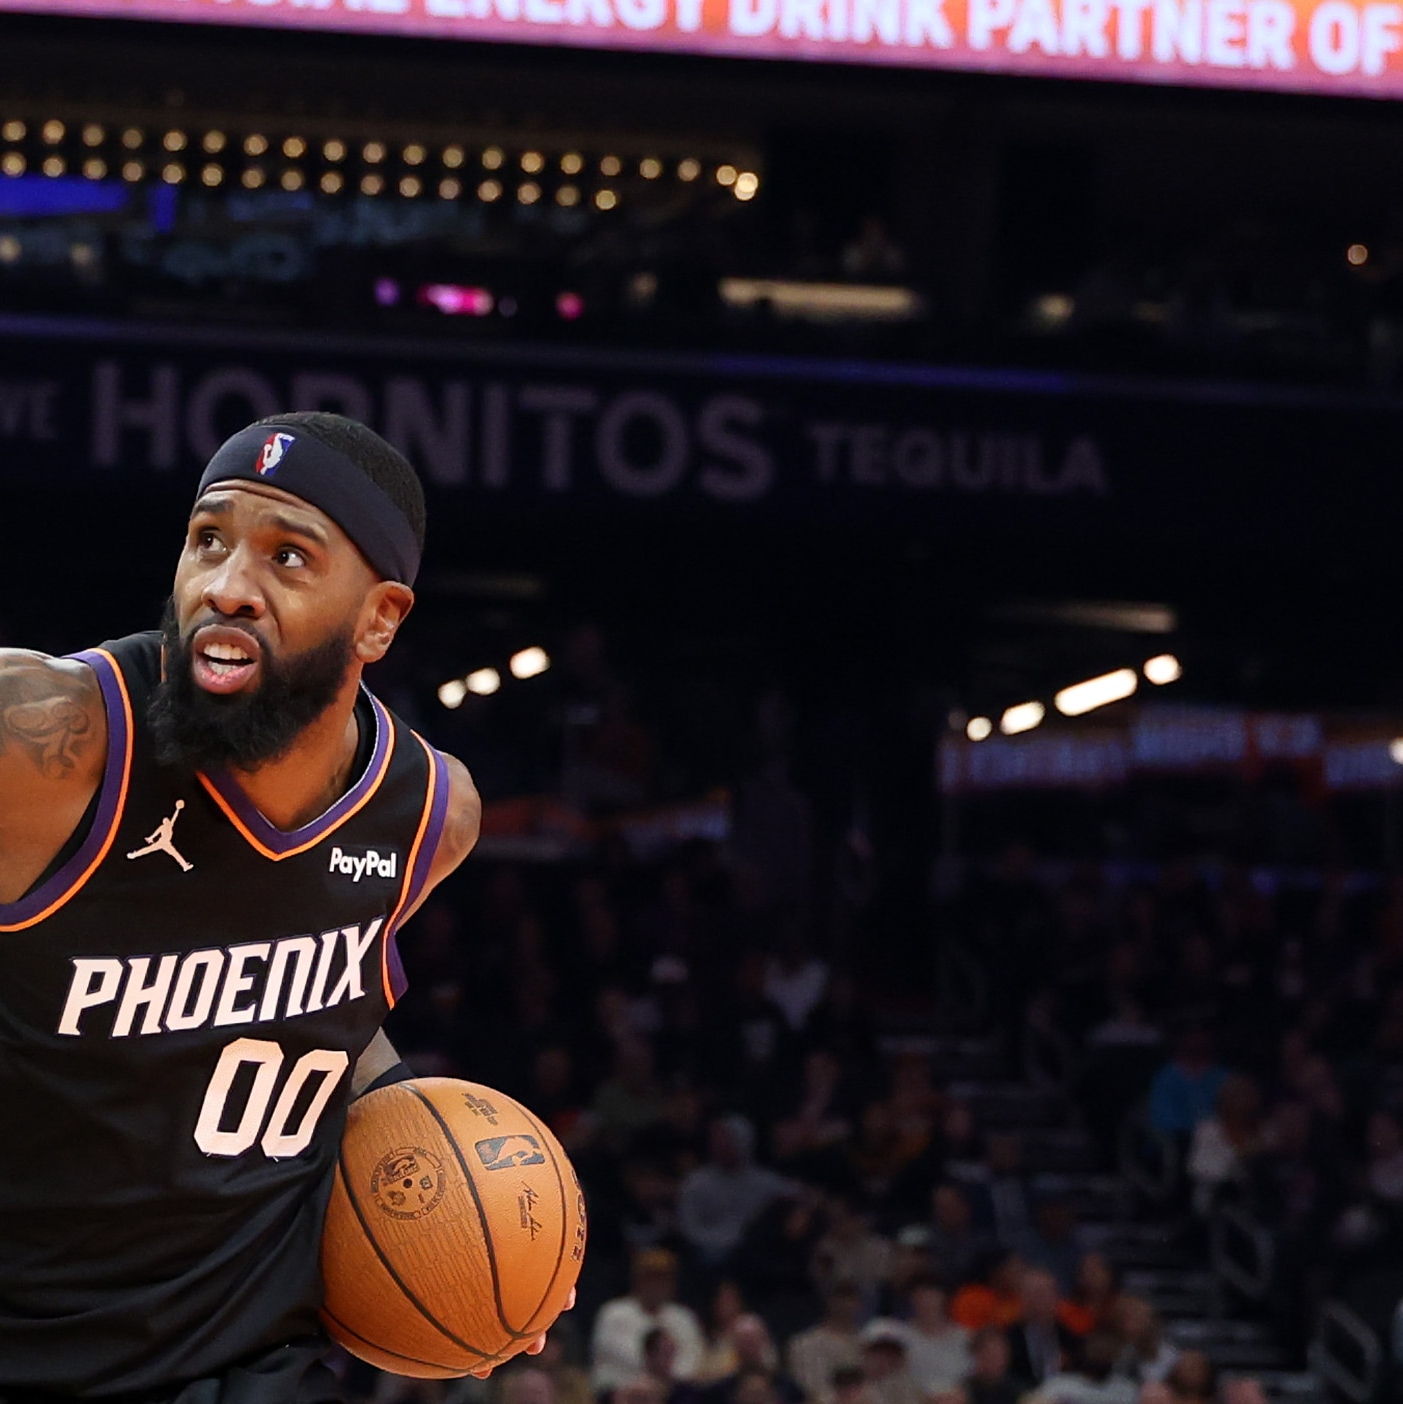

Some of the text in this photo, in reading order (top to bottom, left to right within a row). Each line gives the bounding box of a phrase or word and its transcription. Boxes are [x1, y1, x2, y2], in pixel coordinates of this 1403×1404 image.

[968, 0, 1295, 70] PARTNER
[1309, 2, 1402, 76] OF
[806, 421, 1109, 497] TEQUILA
[329, 846, 396, 882] PayPal
[56, 915, 384, 1038] PHOENIX
[193, 1036, 350, 1158] 00
